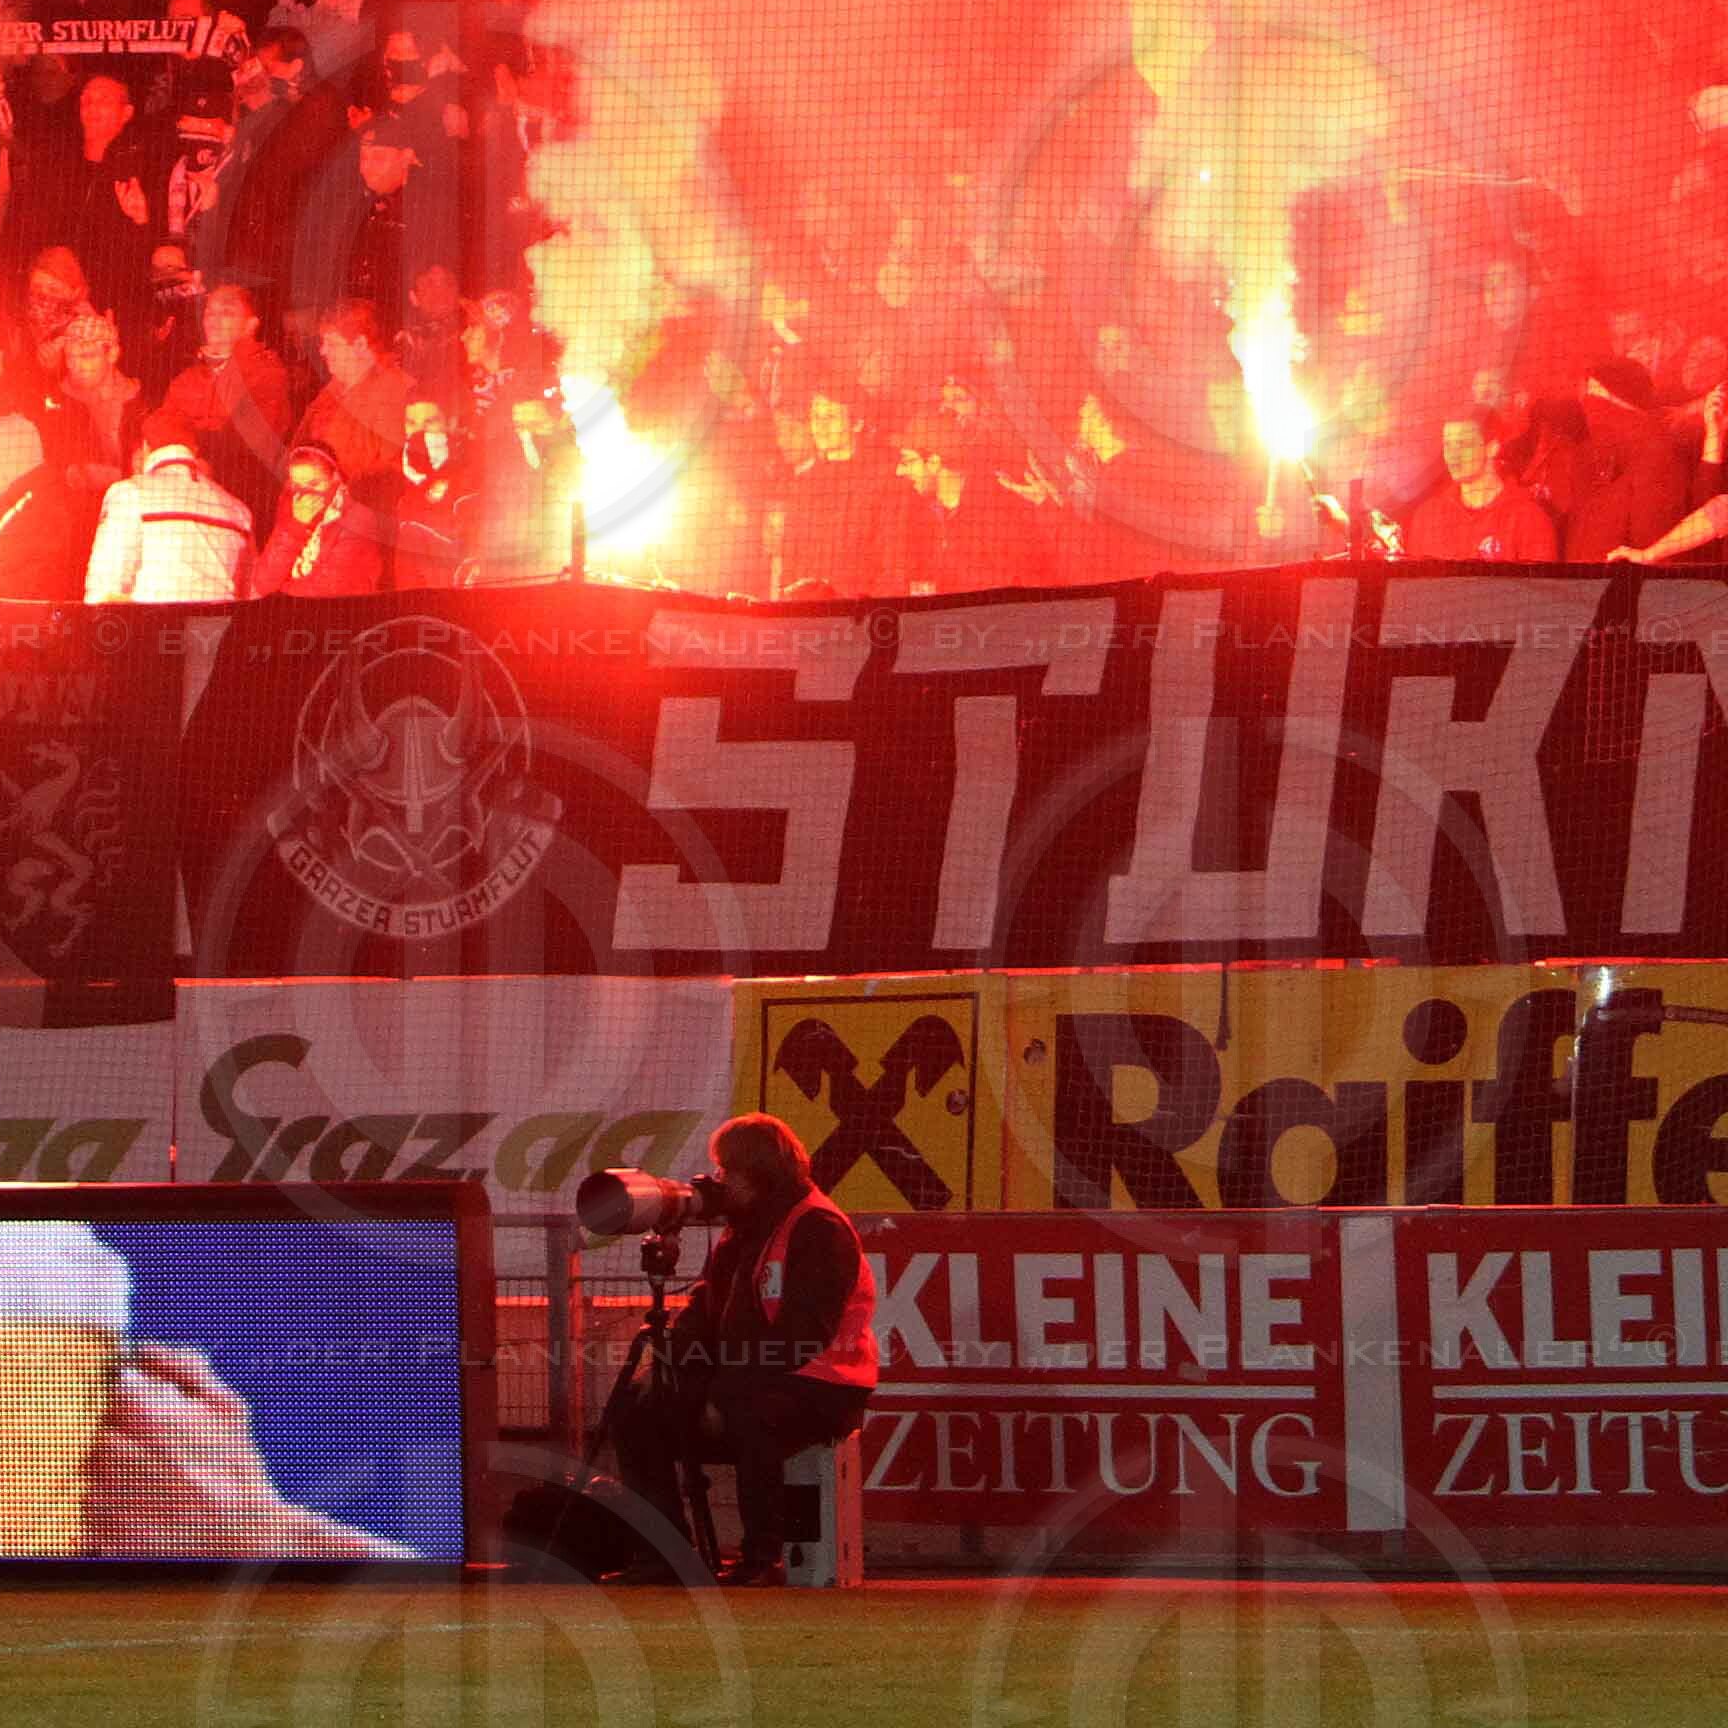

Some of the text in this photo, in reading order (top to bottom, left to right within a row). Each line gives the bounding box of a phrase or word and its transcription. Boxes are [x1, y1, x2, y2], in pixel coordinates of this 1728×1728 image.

[52, 17, 194, 42] STURMFLUT
[288, 828, 544, 935] GRAZER STURMFLUT
[874, 1252, 1316, 1371] KLEINE
[861, 1409, 1323, 1497] ZEITUNG
